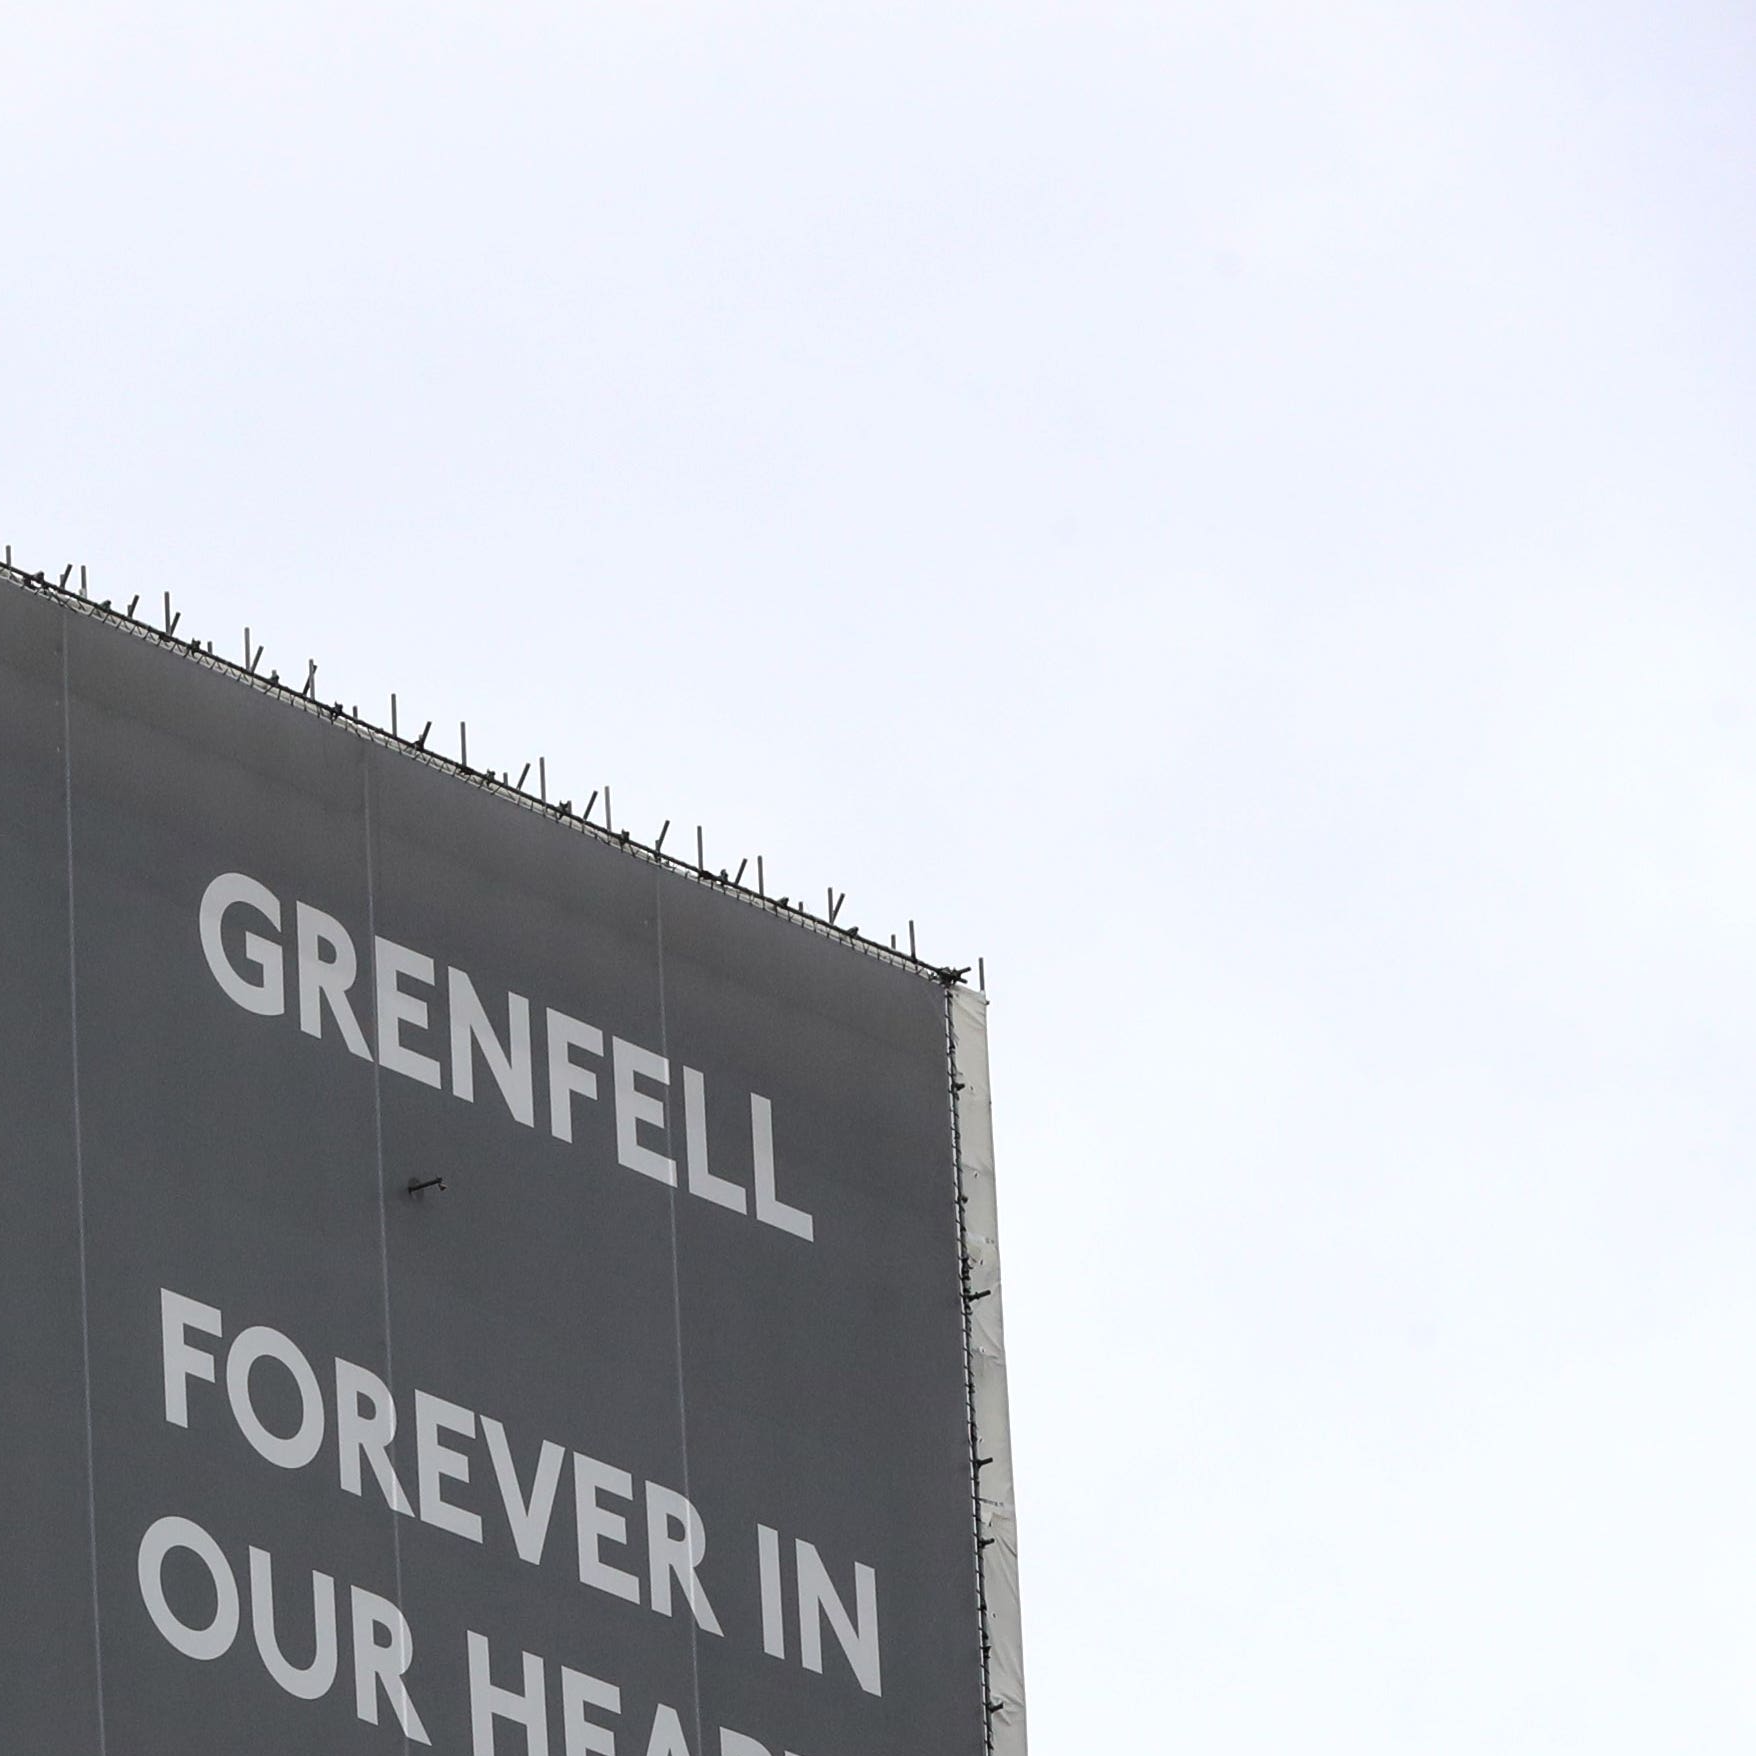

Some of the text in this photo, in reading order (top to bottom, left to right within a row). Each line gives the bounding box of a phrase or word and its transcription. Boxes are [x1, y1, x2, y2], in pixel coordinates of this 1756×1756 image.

[199, 872, 814, 1242] GRENFELL
[138, 1515, 432, 1746] OUR
[160, 1287, 882, 1697] FOREVER IN
